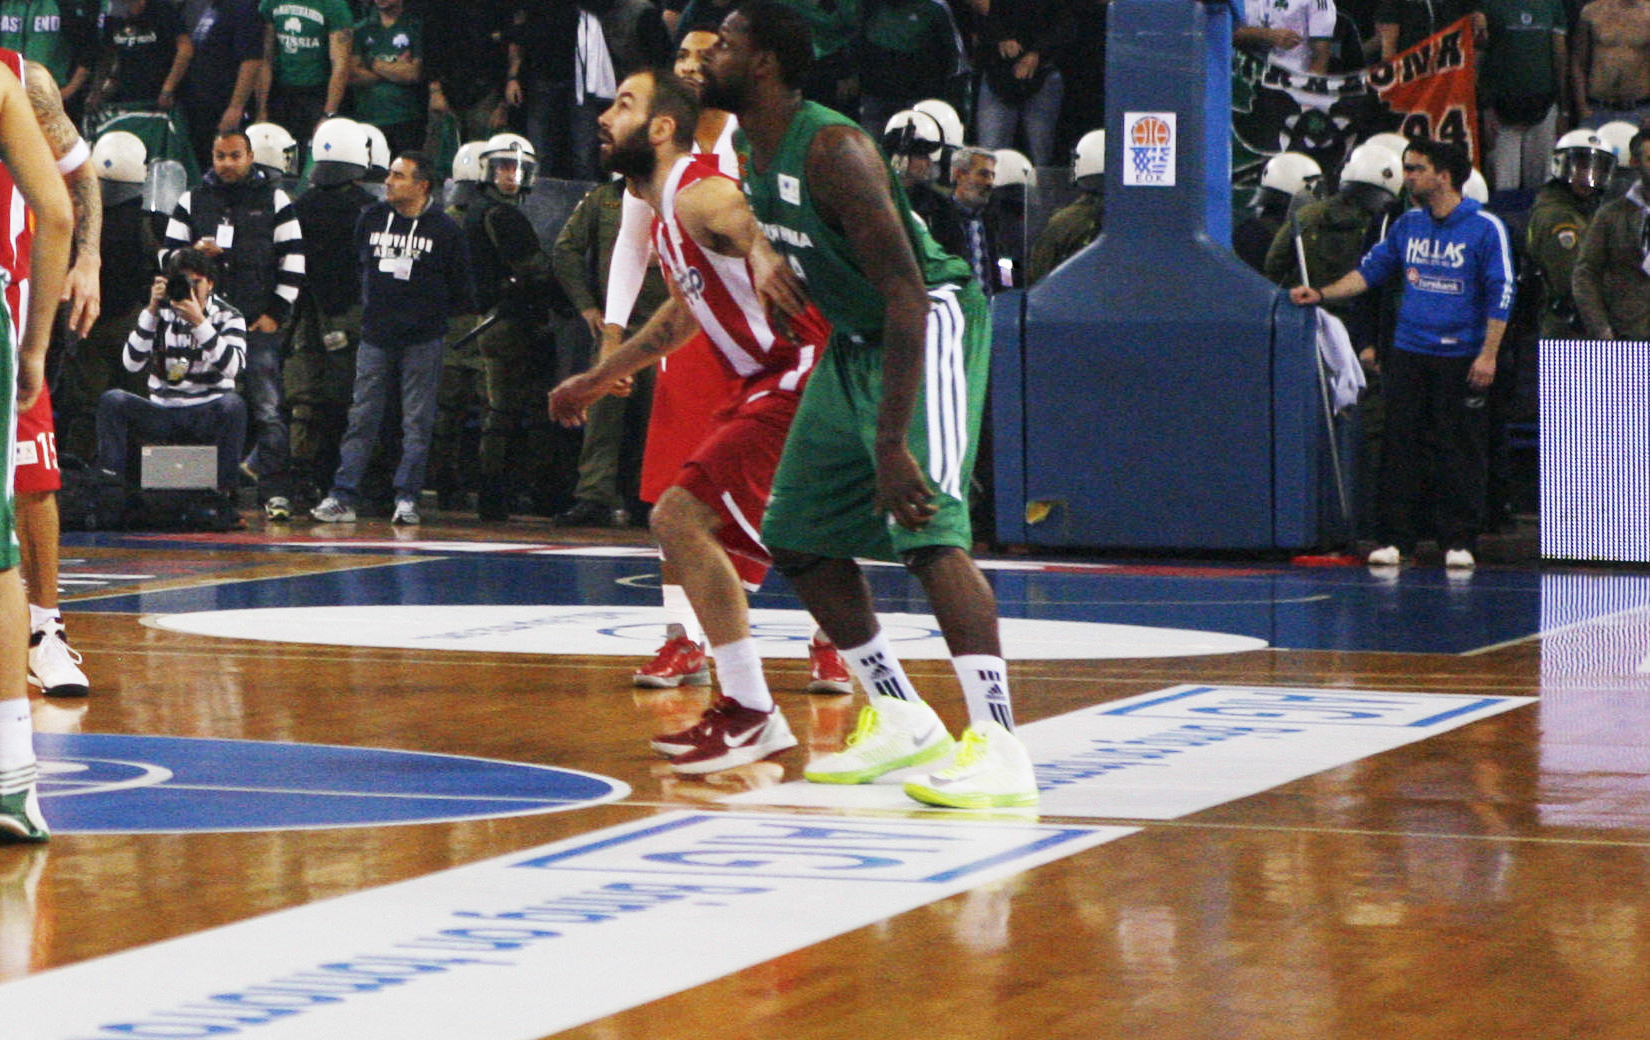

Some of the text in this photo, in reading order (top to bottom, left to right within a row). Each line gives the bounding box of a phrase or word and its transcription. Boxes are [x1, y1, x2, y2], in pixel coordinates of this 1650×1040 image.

[1187, 691, 1416, 722] AIG
[640, 823, 972, 871] AIG
[64, 881, 777, 1040] Bring on tomorro
